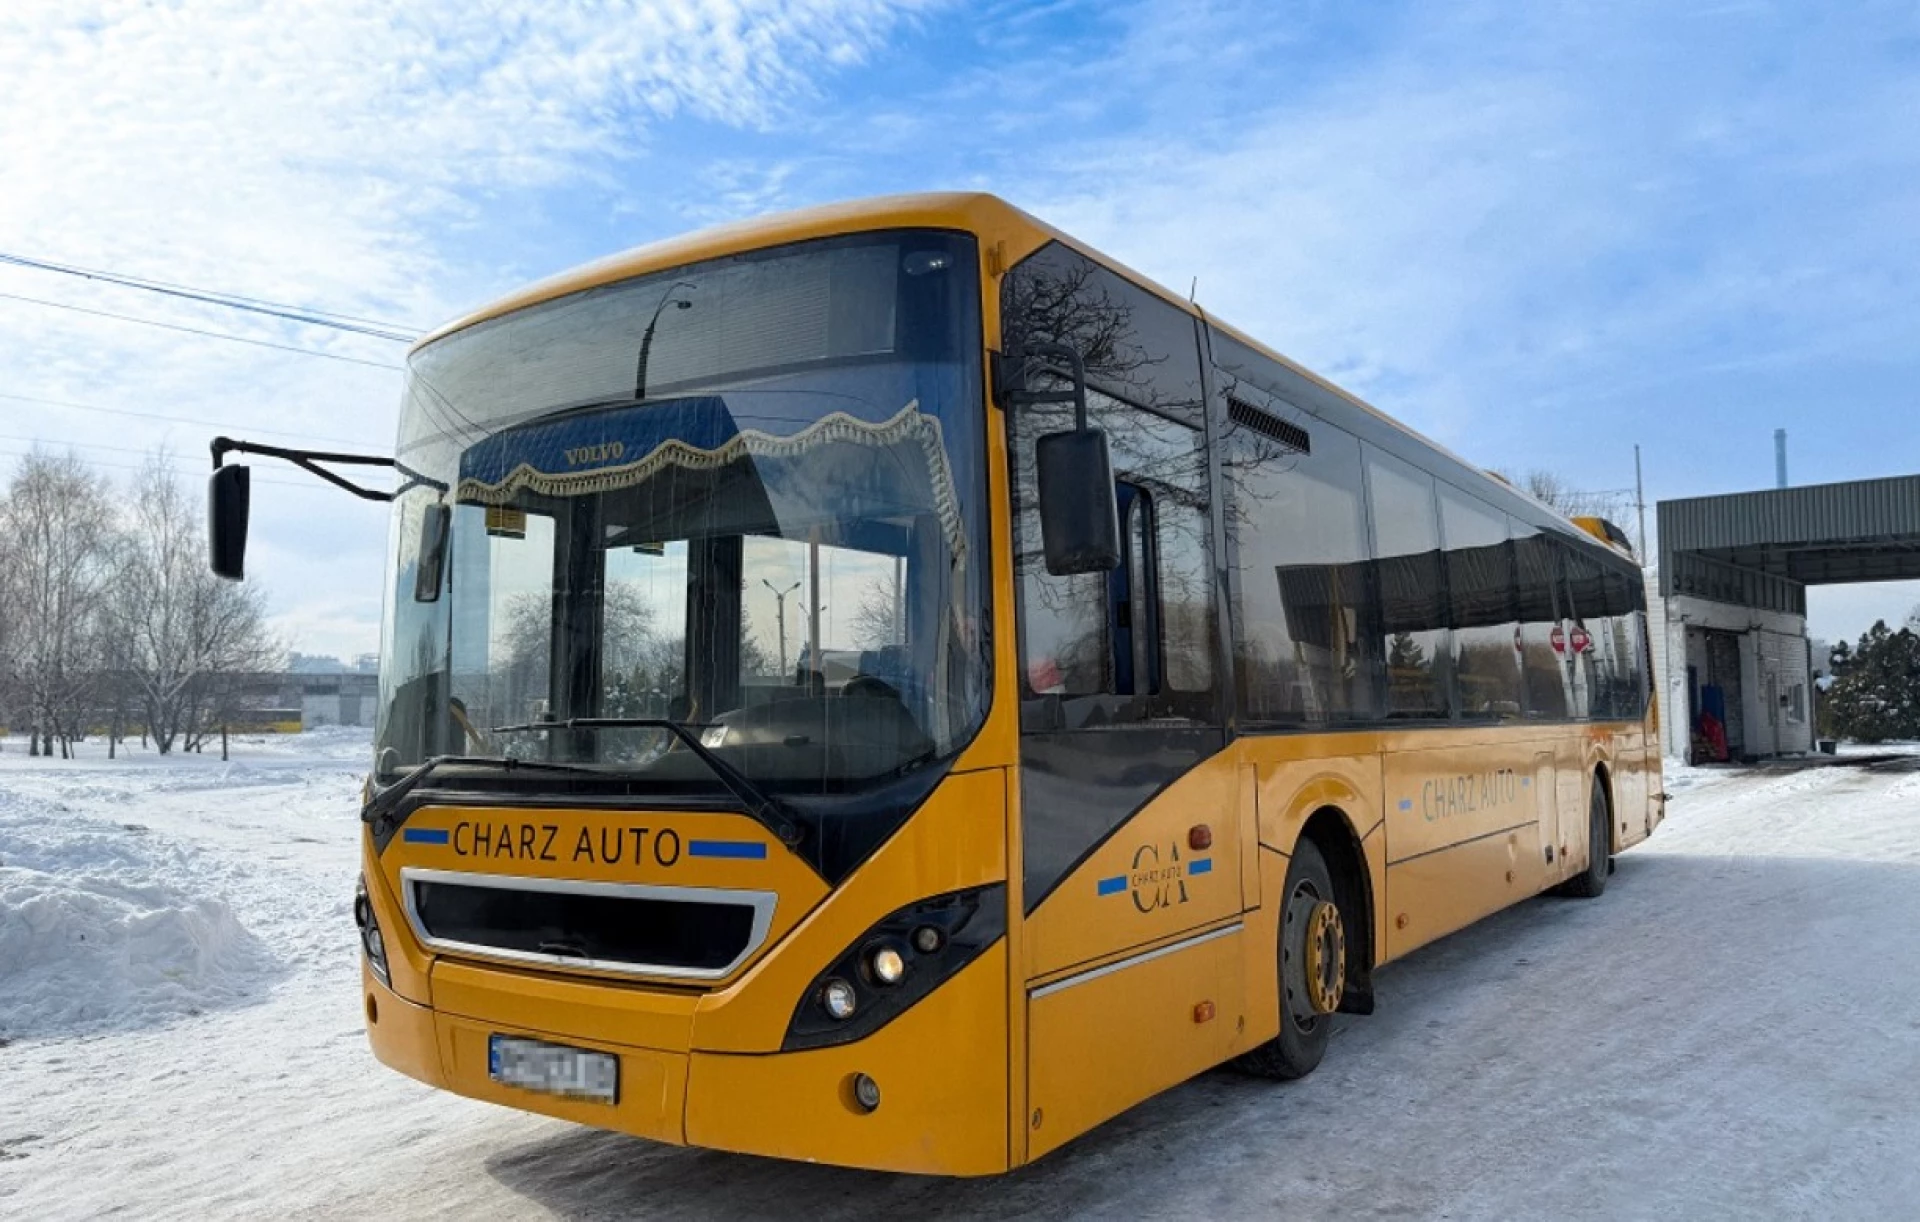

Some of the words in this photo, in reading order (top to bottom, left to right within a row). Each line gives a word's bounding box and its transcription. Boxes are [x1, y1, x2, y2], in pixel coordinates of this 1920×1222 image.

[566, 441, 624, 465] VOLVO
[1422, 774, 1476, 822] CHARZ
[1481, 768, 1514, 810] AUTO
[453, 822, 558, 862] CHARZ
[573, 827, 681, 867] AUTO
